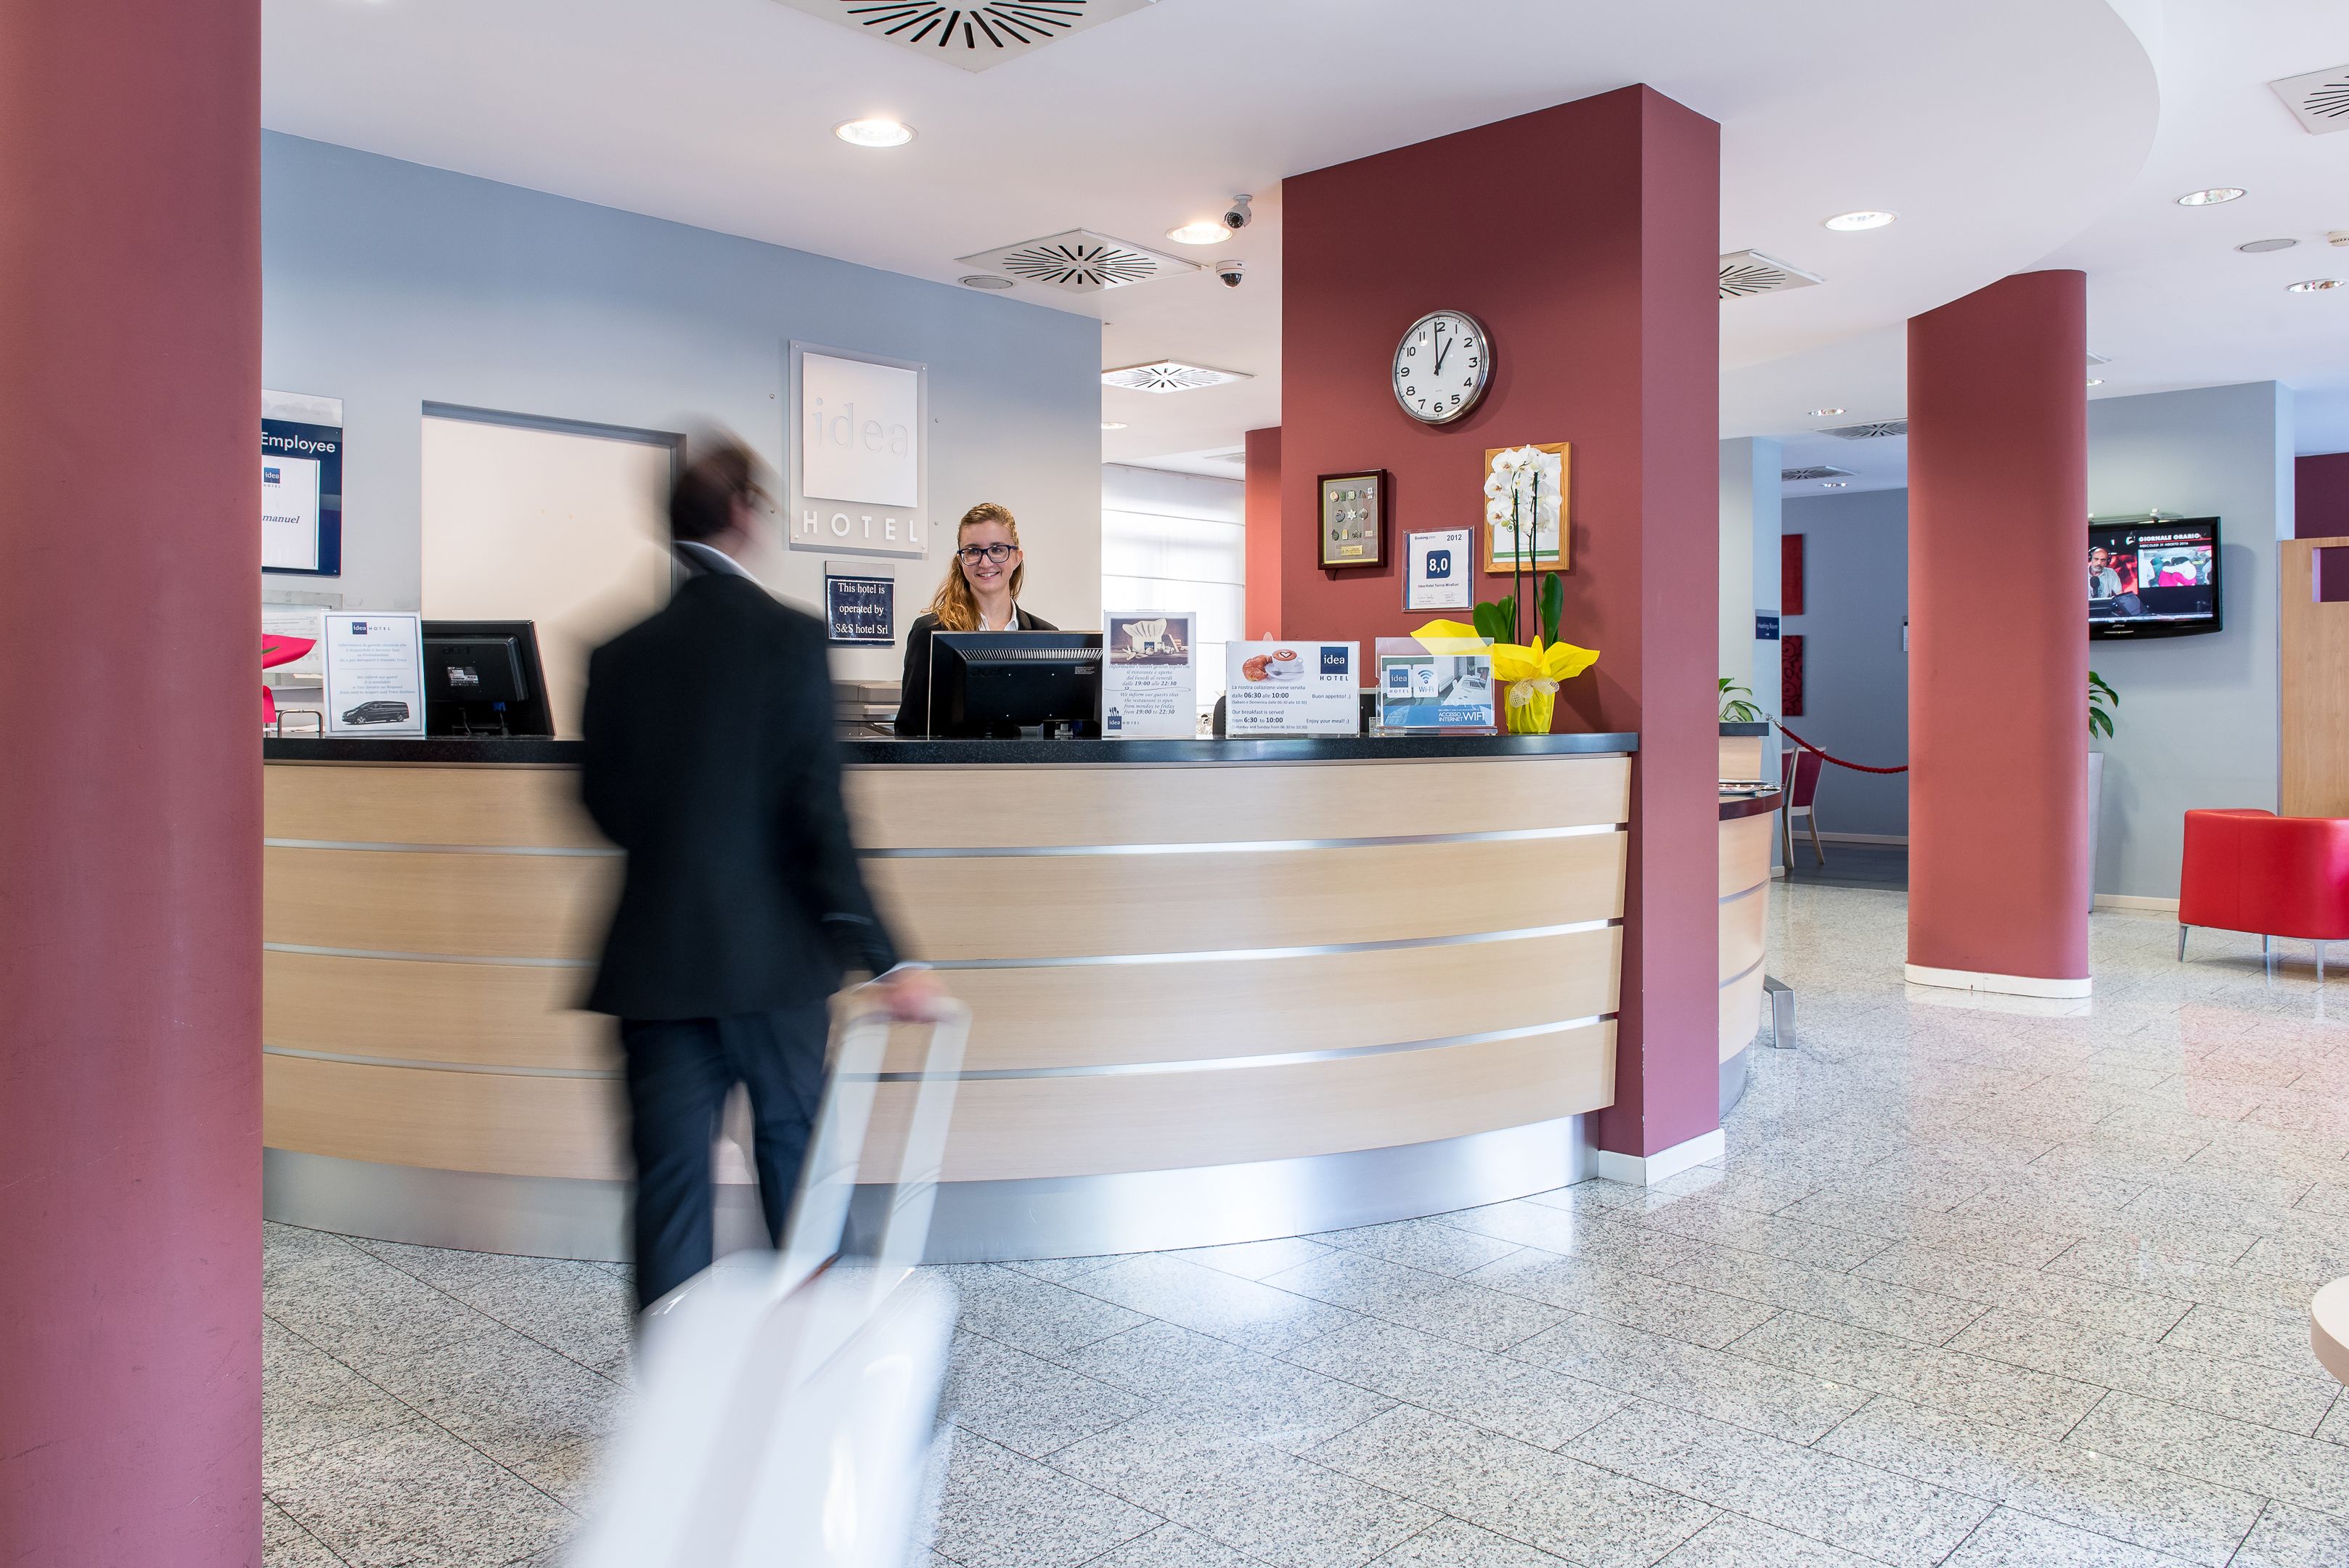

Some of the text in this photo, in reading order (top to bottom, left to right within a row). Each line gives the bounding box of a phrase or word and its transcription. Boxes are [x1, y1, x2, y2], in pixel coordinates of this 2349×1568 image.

[1464, 338, 1472, 348] 2
[1408, 347, 1415, 356] 10
[1468, 357, 1477, 367] 3
[1401, 367, 1410, 377] 9
[1463, 377, 1472, 387] 4
[1406, 386, 1415, 396] 8
[1418, 399, 1426, 409] 7
[1451, 394, 1460, 404] 5
[1434, 402, 1443, 412] 6
[811, 397, 909, 459] idea
[261, 432, 335, 454] Employee
[803, 510, 918, 542] HOTEL
[1429, 558, 1448, 573] 8,0
[838, 583, 885, 594] This hotel is
[839, 605, 883, 616] operated by
[836, 624, 888, 634] S&S hotel Srl
[1323, 655, 1345, 664] idea
[1463, 712, 1484, 721] WIFI
